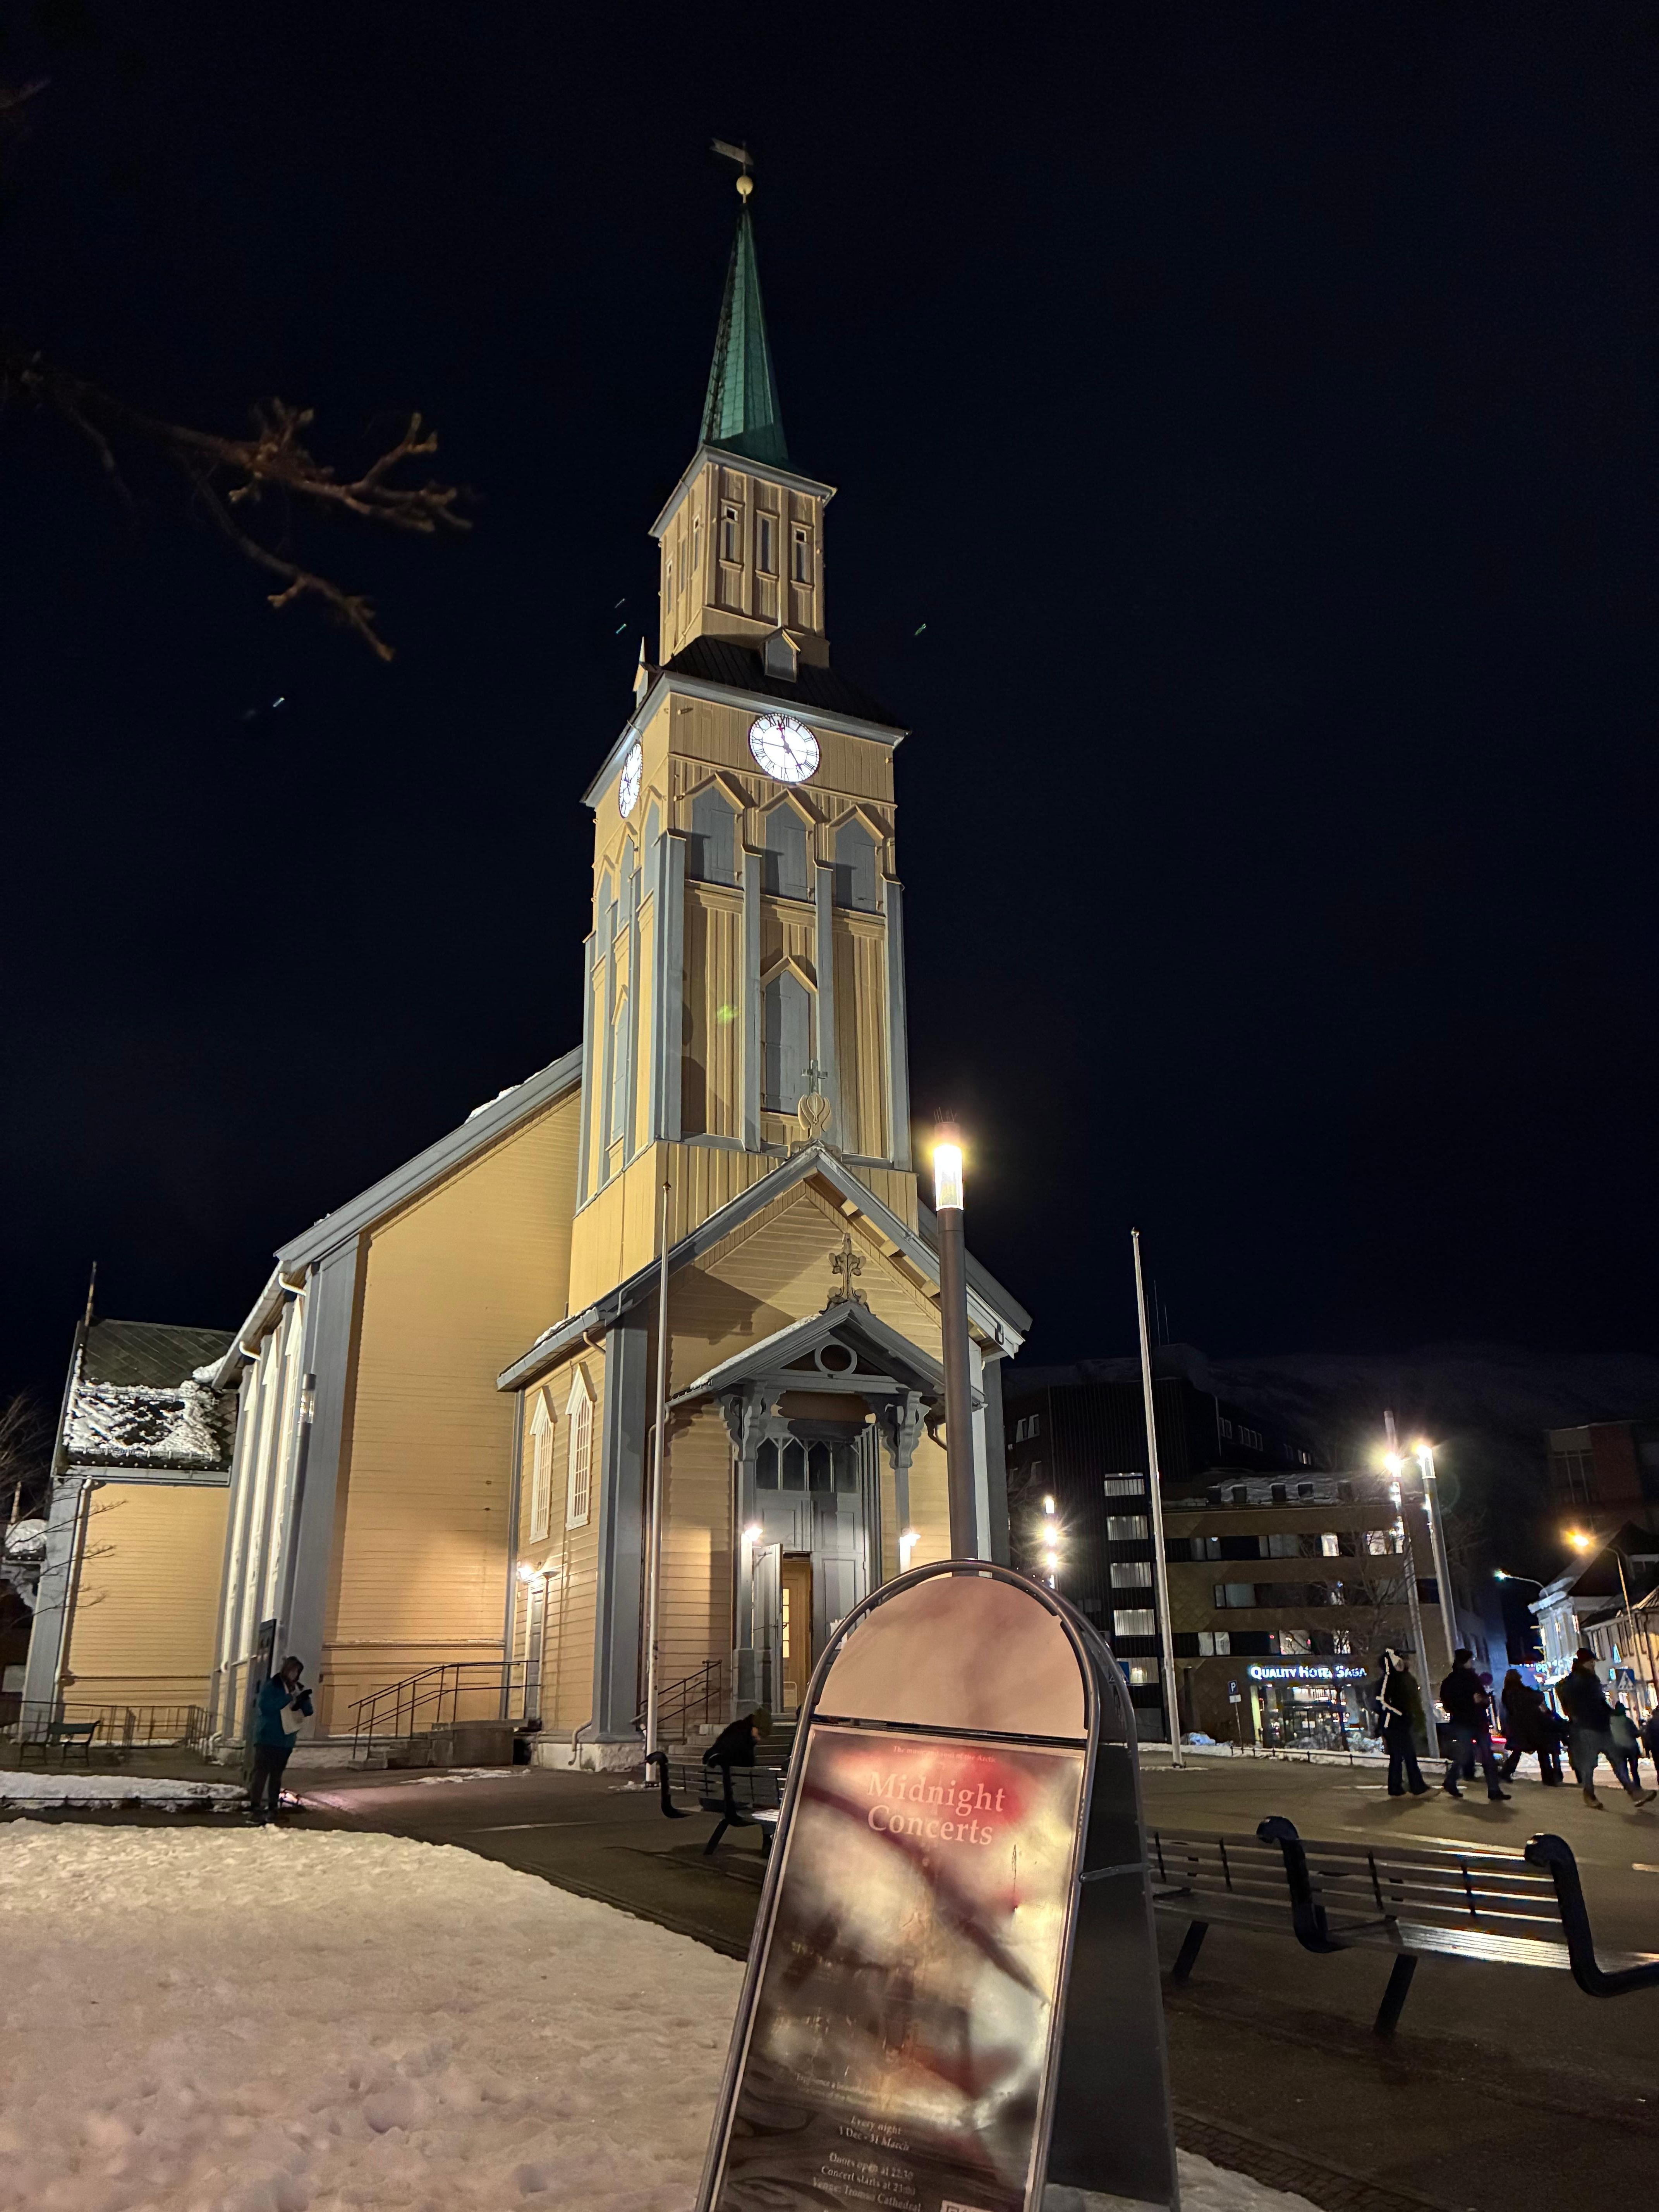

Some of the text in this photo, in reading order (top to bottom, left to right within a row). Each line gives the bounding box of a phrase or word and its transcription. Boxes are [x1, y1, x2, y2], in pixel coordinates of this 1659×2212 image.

[1251, 1665, 1367, 1680] QUALITY HOTEL SAGA
[1231, 1682, 1236, 1692] P
[867, 1771, 1005, 1816] Midnight
[868, 1804, 993, 1845] Concerts
[846, 2127, 862, 2140] Dec
[880, 2135, 910, 2151] March
[878, 2123, 902, 2136] night
[829, 2151, 855, 2167] Doors
[880, 2166, 889, 2177] at
[821, 2164, 855, 2182] Concert
[857, 2174, 881, 2188] starts
[882, 2181, 891, 2191] at
[877, 2192, 922, 2212] Cathedral
